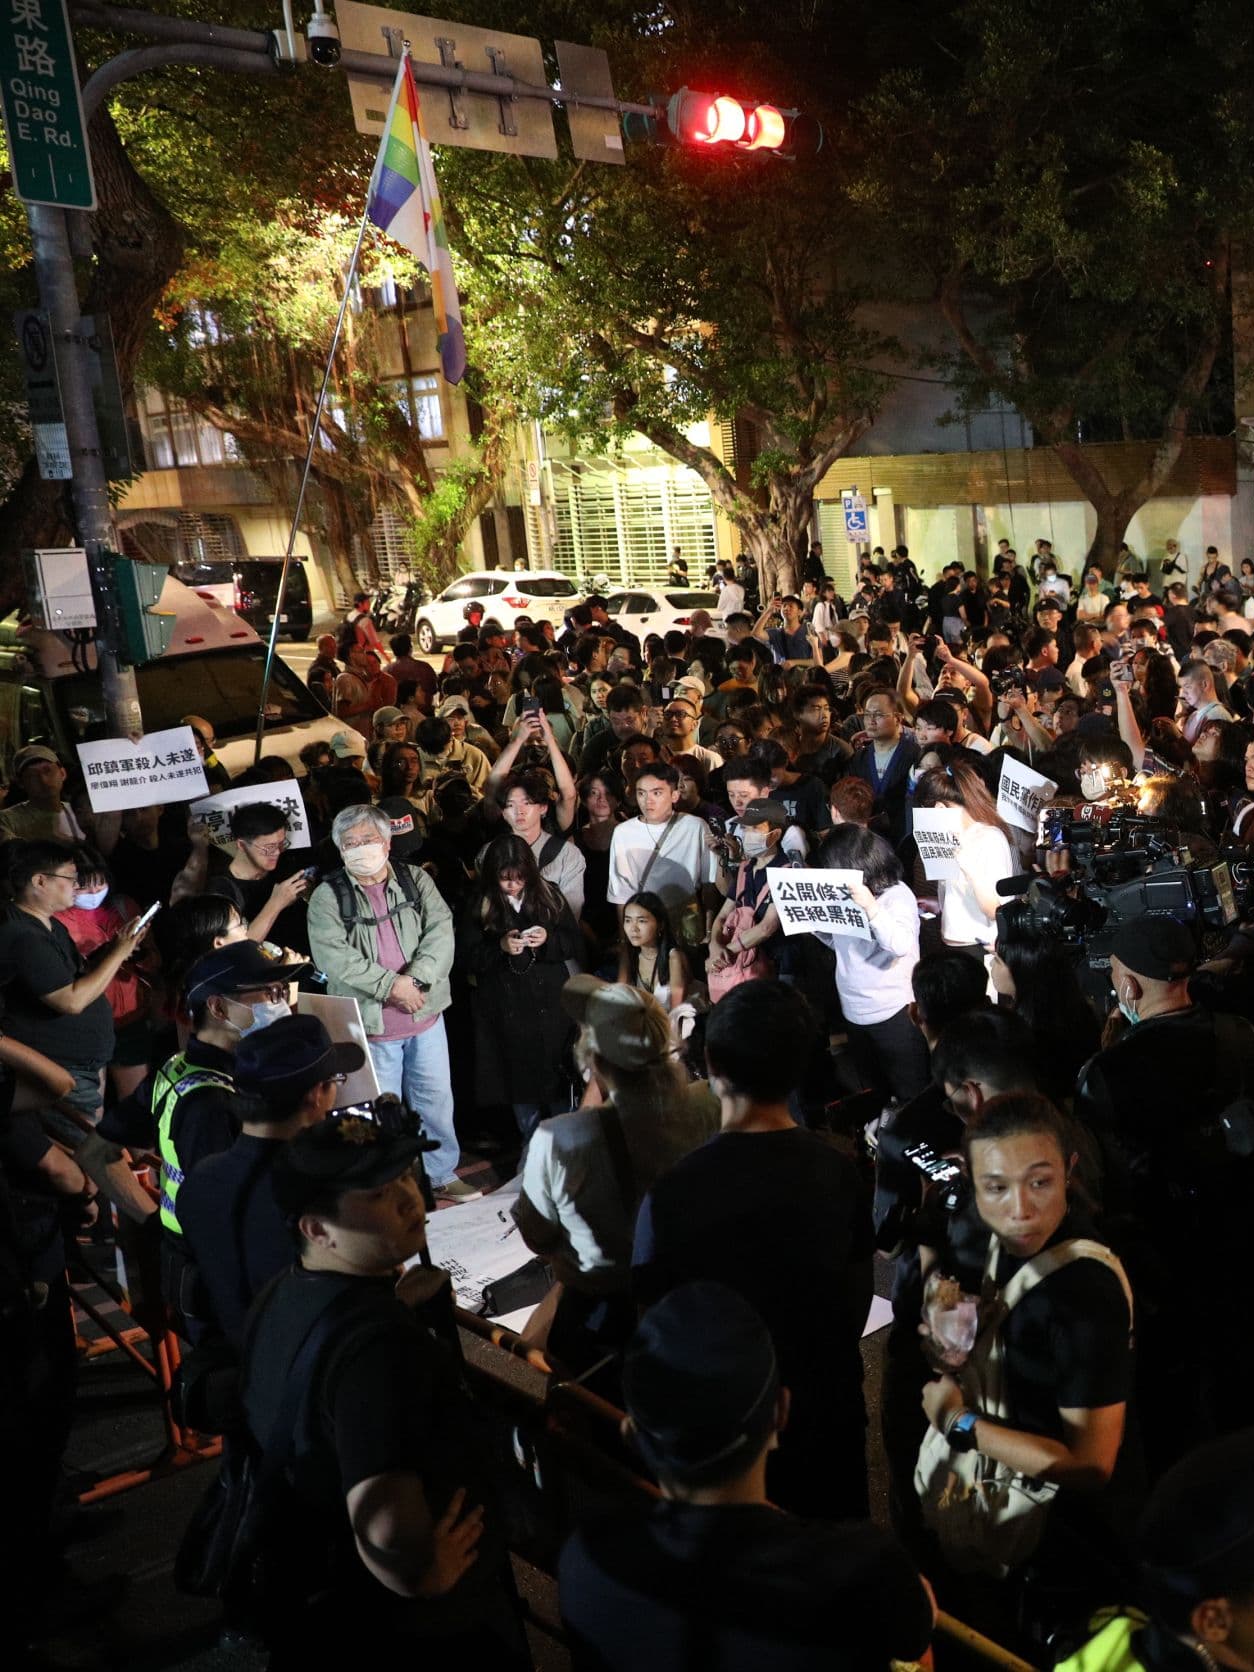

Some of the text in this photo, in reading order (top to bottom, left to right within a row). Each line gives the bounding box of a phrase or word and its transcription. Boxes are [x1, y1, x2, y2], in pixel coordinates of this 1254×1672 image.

[10, 78, 60, 106] Qing
[15, 100, 57, 123] Dao
[17, 123, 77, 148] E. Rd.
[87, 748, 196, 776] 邱鎮軍殺人未遂
[777, 881, 854, 902] 公開條文
[784, 905, 865, 929] 拒絕黑箱
